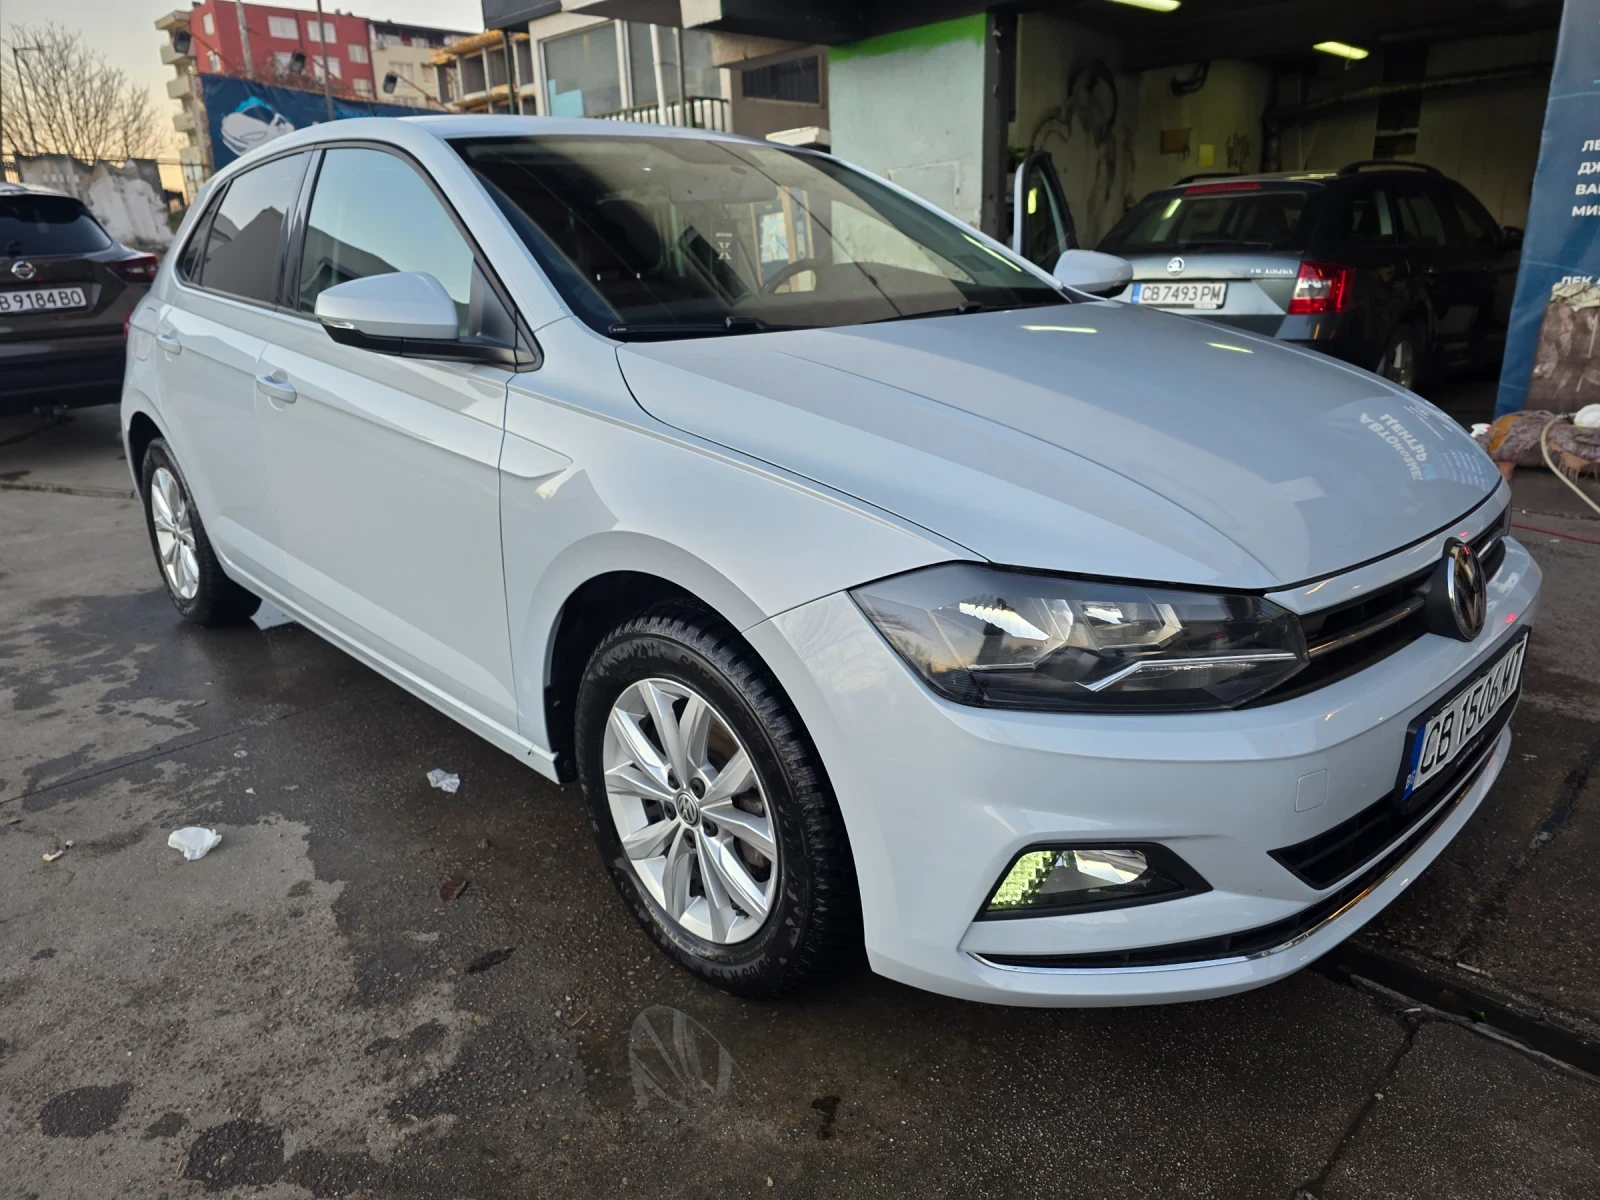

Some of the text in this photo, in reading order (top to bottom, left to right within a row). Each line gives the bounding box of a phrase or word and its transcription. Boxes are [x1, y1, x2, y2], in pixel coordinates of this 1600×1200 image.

[13, 292, 57, 309] 9184
[1142, 286, 1160, 301] CB
[1162, 286, 1198, 301] 7493
[1200, 286, 1222, 301] PM
[1420, 710, 1455, 774] CB
[1457, 666, 1502, 745] 1506
